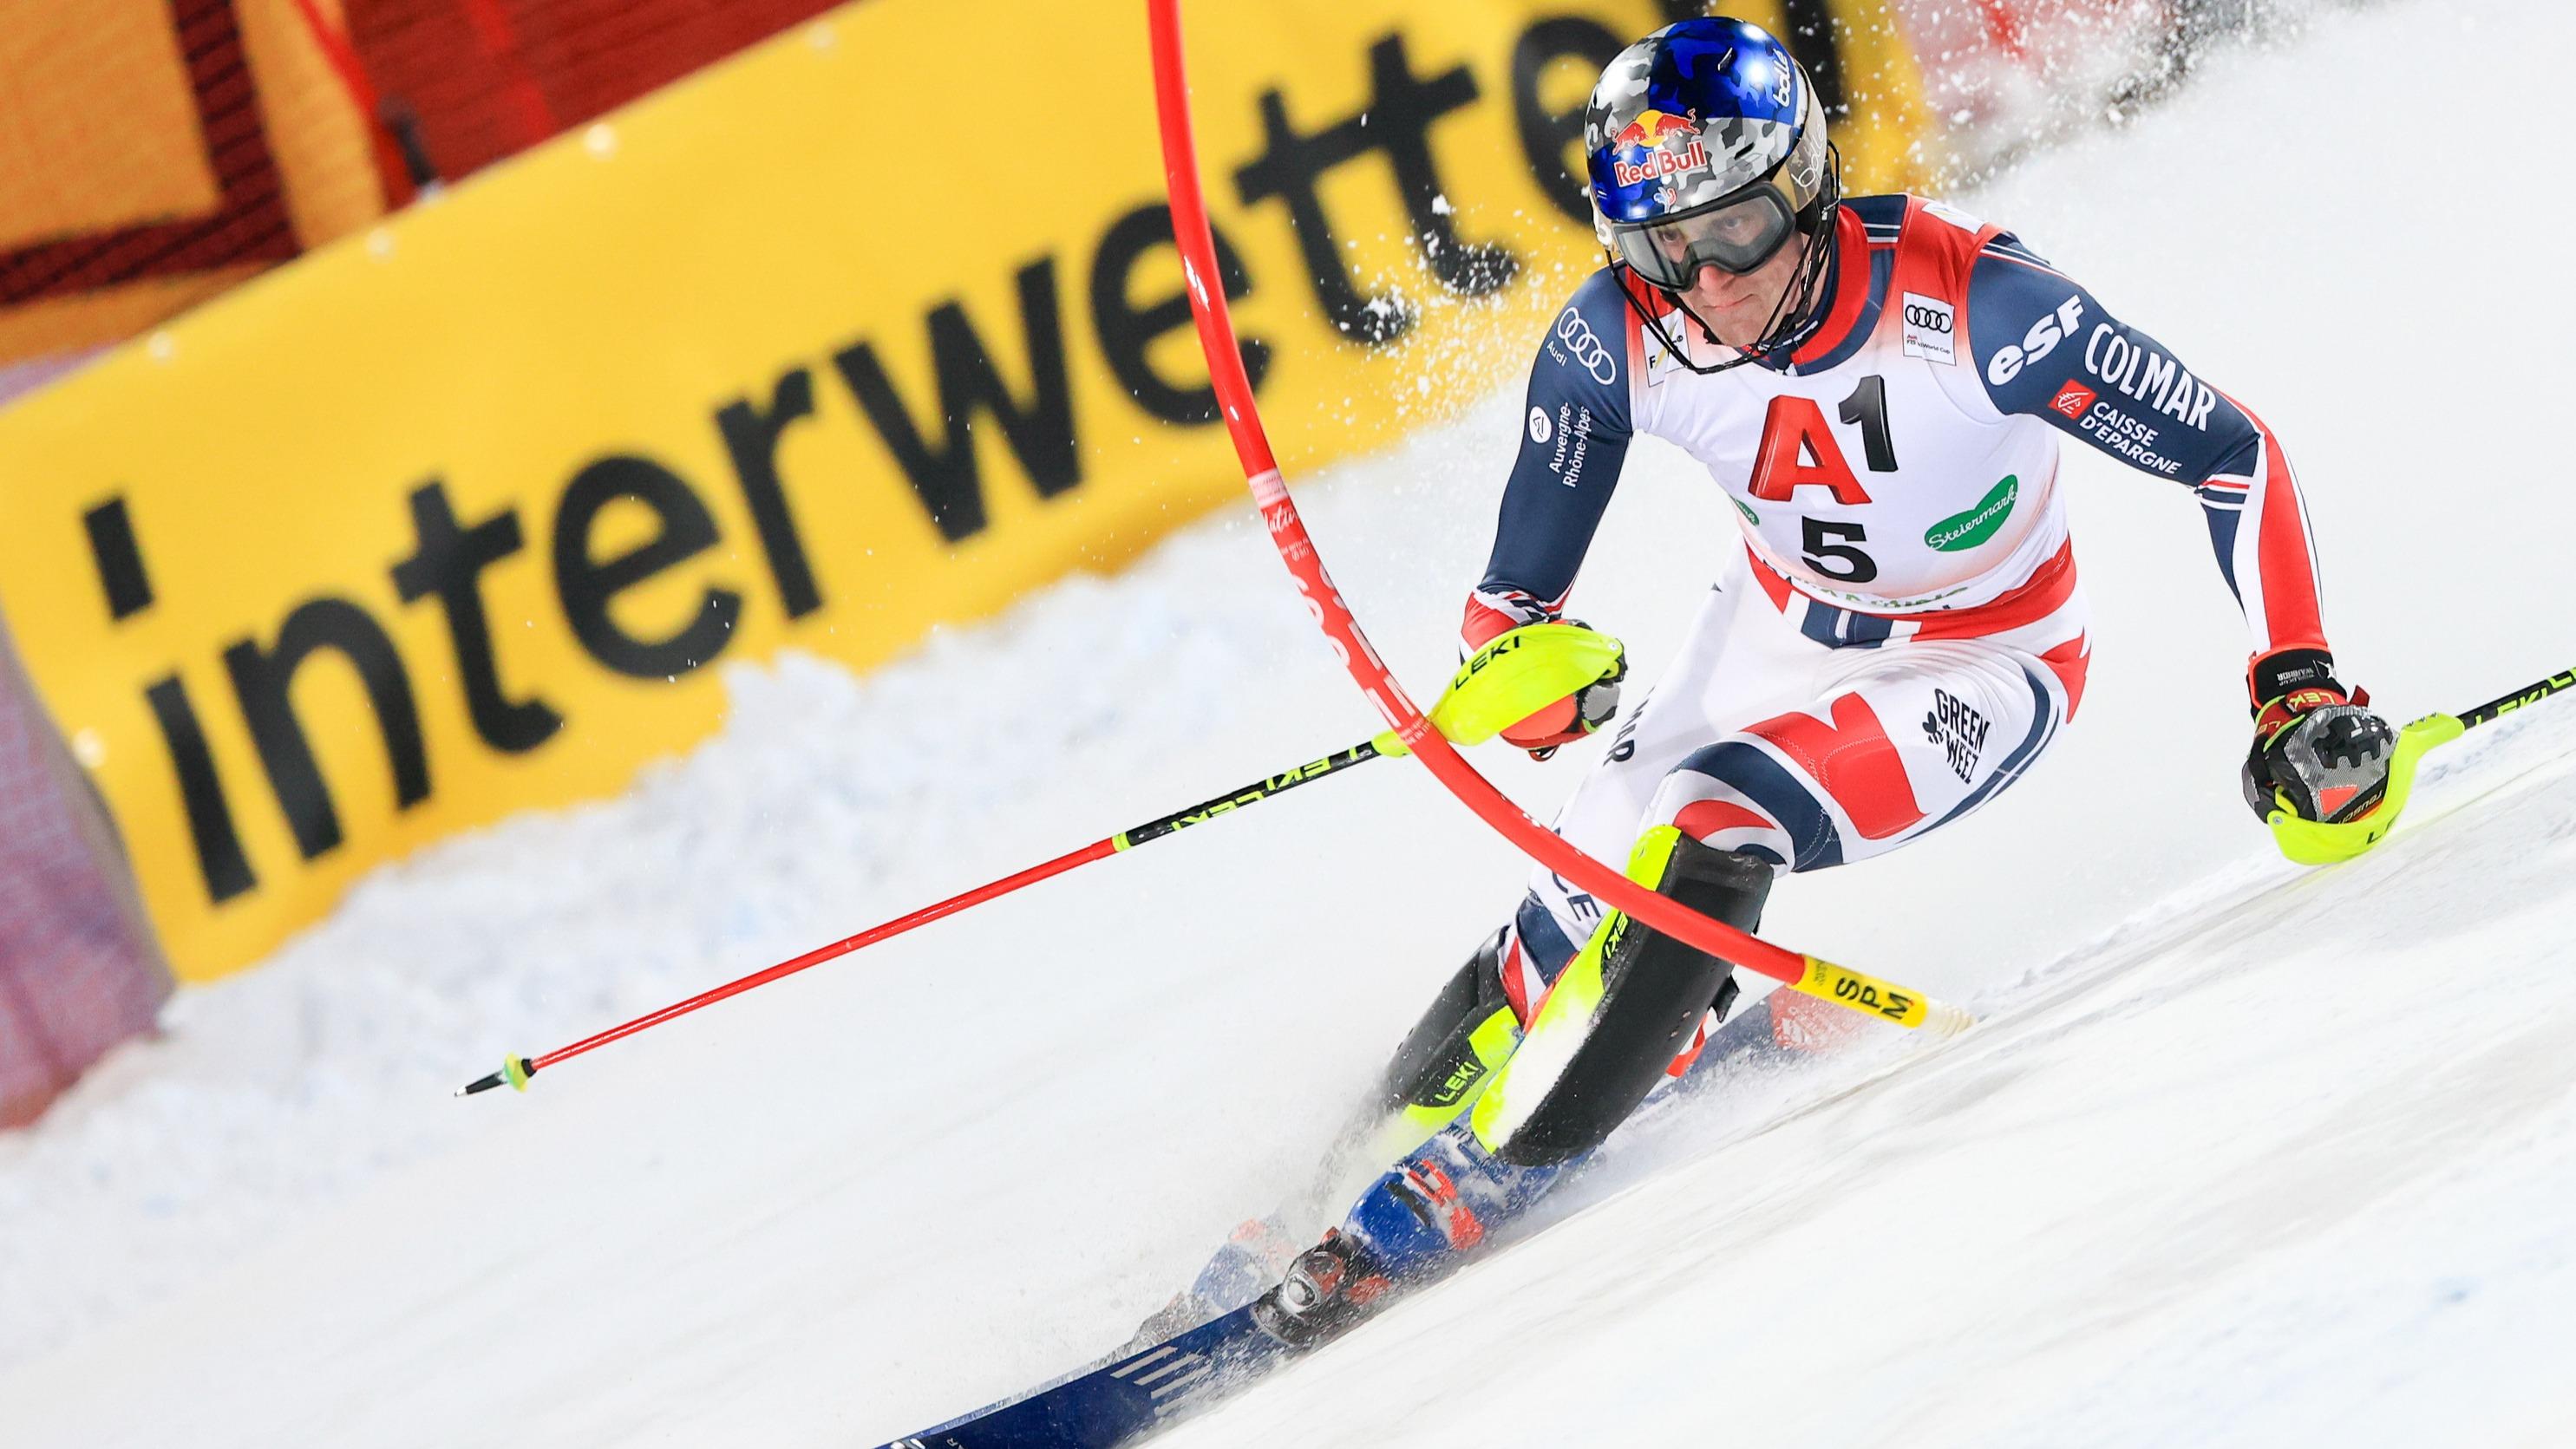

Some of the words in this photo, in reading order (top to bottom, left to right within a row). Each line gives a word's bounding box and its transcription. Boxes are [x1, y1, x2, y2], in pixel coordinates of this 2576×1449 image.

[1614, 152, 1657, 187] Red
[1658, 140, 1707, 174] Bull
[1546, 340, 1566, 367] Audi
[1987, 295, 2083, 386] esf
[2084, 323, 2217, 432] COLMAR
[1549, 401, 1572, 473] Auvergne-
[1562, 406, 1592, 488] Rhône-Alpes
[2079, 414, 2182, 475] D'EPARGNE
[2093, 401, 2159, 447] CAISSE
[1928, 484, 2017, 551] Steiermark
[1801, 515, 1878, 584] 5
[1455, 635, 1520, 690] LEKI
[1934, 688, 1991, 754] GREEN
[1945, 729, 1978, 785] WEEZ
[1435, 1061, 1479, 1102] LEKI
